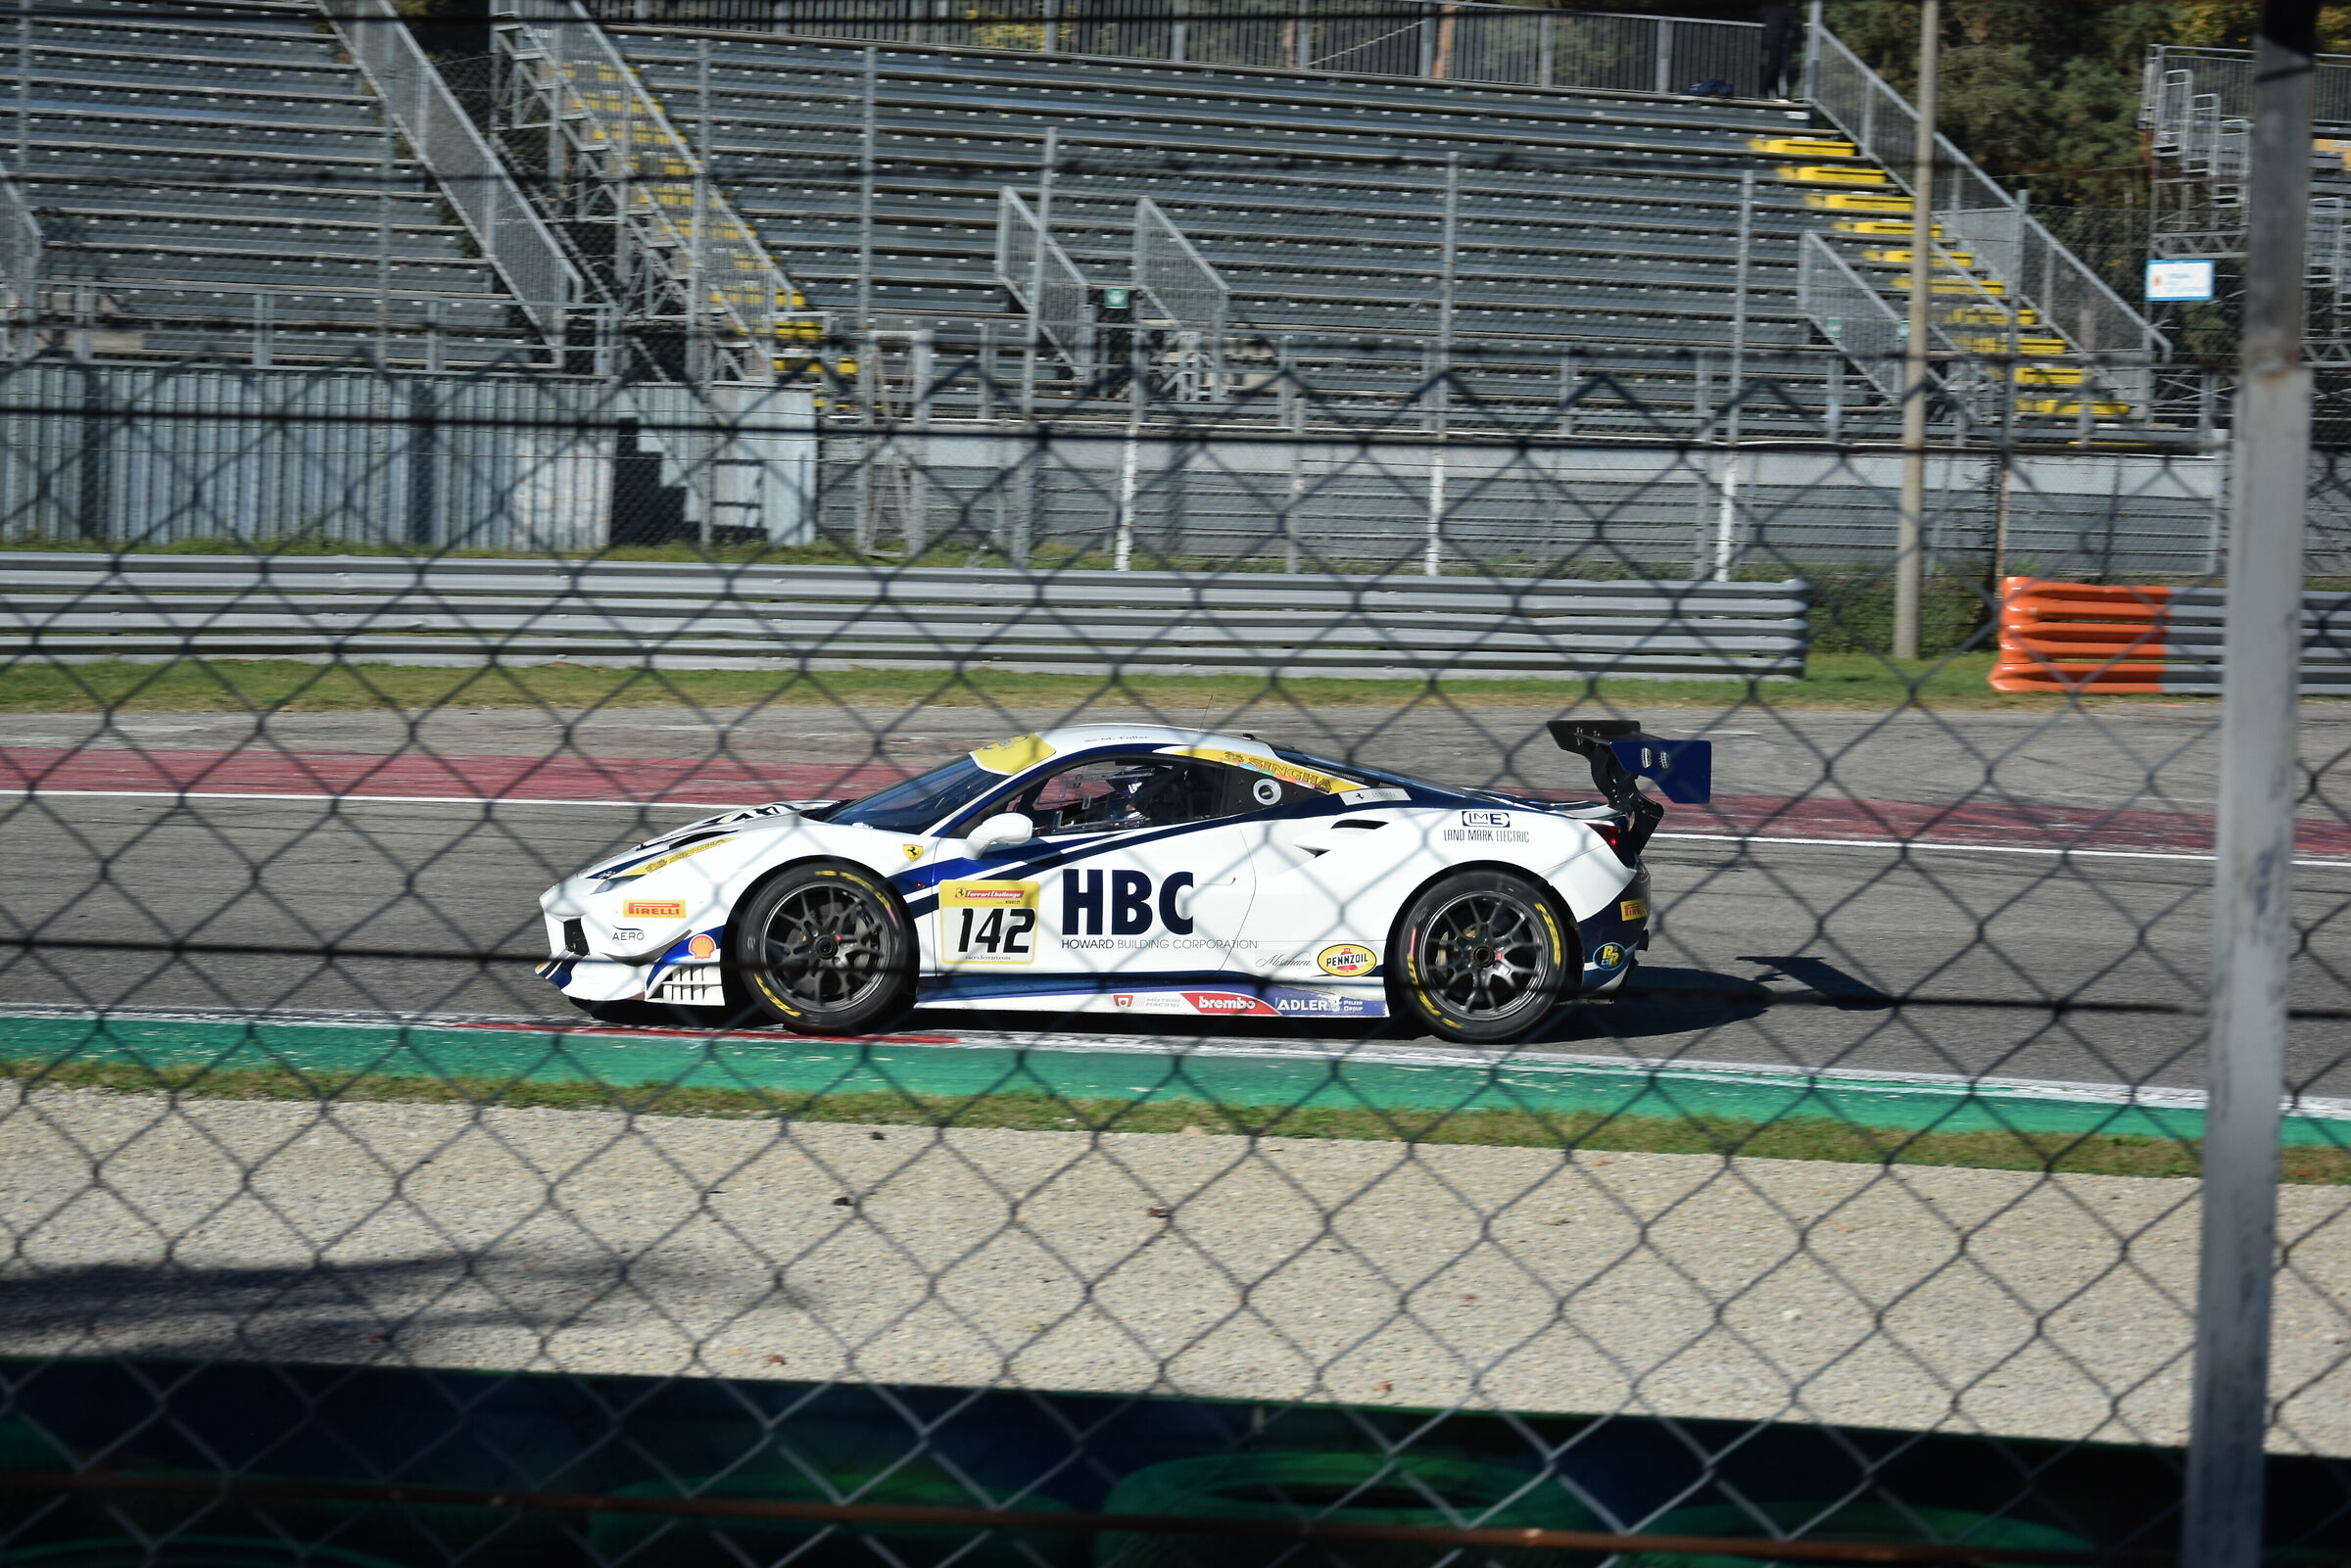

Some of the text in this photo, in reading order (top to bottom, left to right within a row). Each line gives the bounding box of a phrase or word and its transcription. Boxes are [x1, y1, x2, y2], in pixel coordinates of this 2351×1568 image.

[1247, 757, 1333, 790] SINGHA
[1467, 830, 1494, 842] MARK
[1496, 830, 1530, 843] ELECTRIC
[628, 902, 681, 915] PIRELLI
[1062, 869, 1194, 935] HBC
[611, 931, 645, 941] AERO
[958, 908, 1036, 954] 142
[1061, 938, 1259, 950] HOWARD BUILDING CORPORATION
[1325, 952, 1369, 968] PENNZOIL
[1198, 996, 1257, 1010] brembo
[1276, 999, 1328, 1011] ADLER
